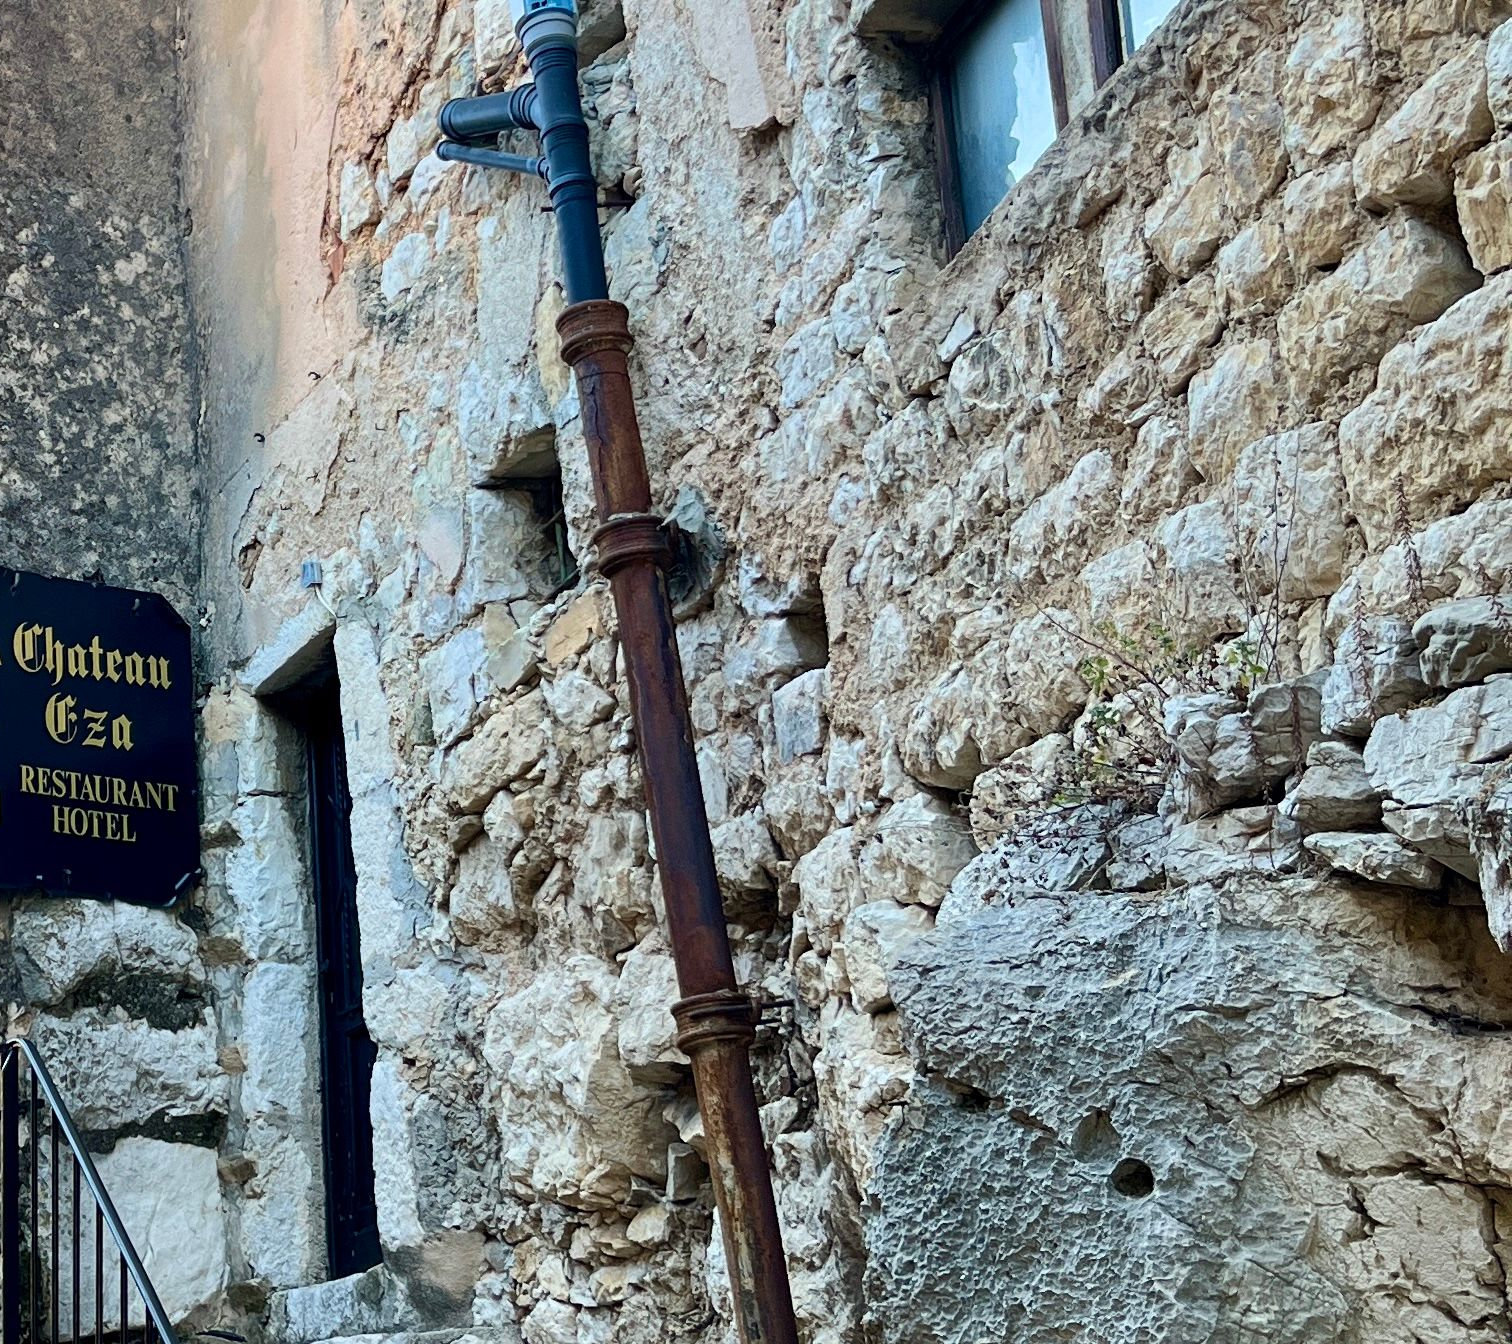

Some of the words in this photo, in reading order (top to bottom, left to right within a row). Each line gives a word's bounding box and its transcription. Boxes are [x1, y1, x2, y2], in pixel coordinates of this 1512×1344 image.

[12, 621, 172, 690] Chateau
[45, 691, 135, 752] Eza
[19, 764, 179, 812] RESTAURANT
[51, 805, 137, 843] HOTEL
